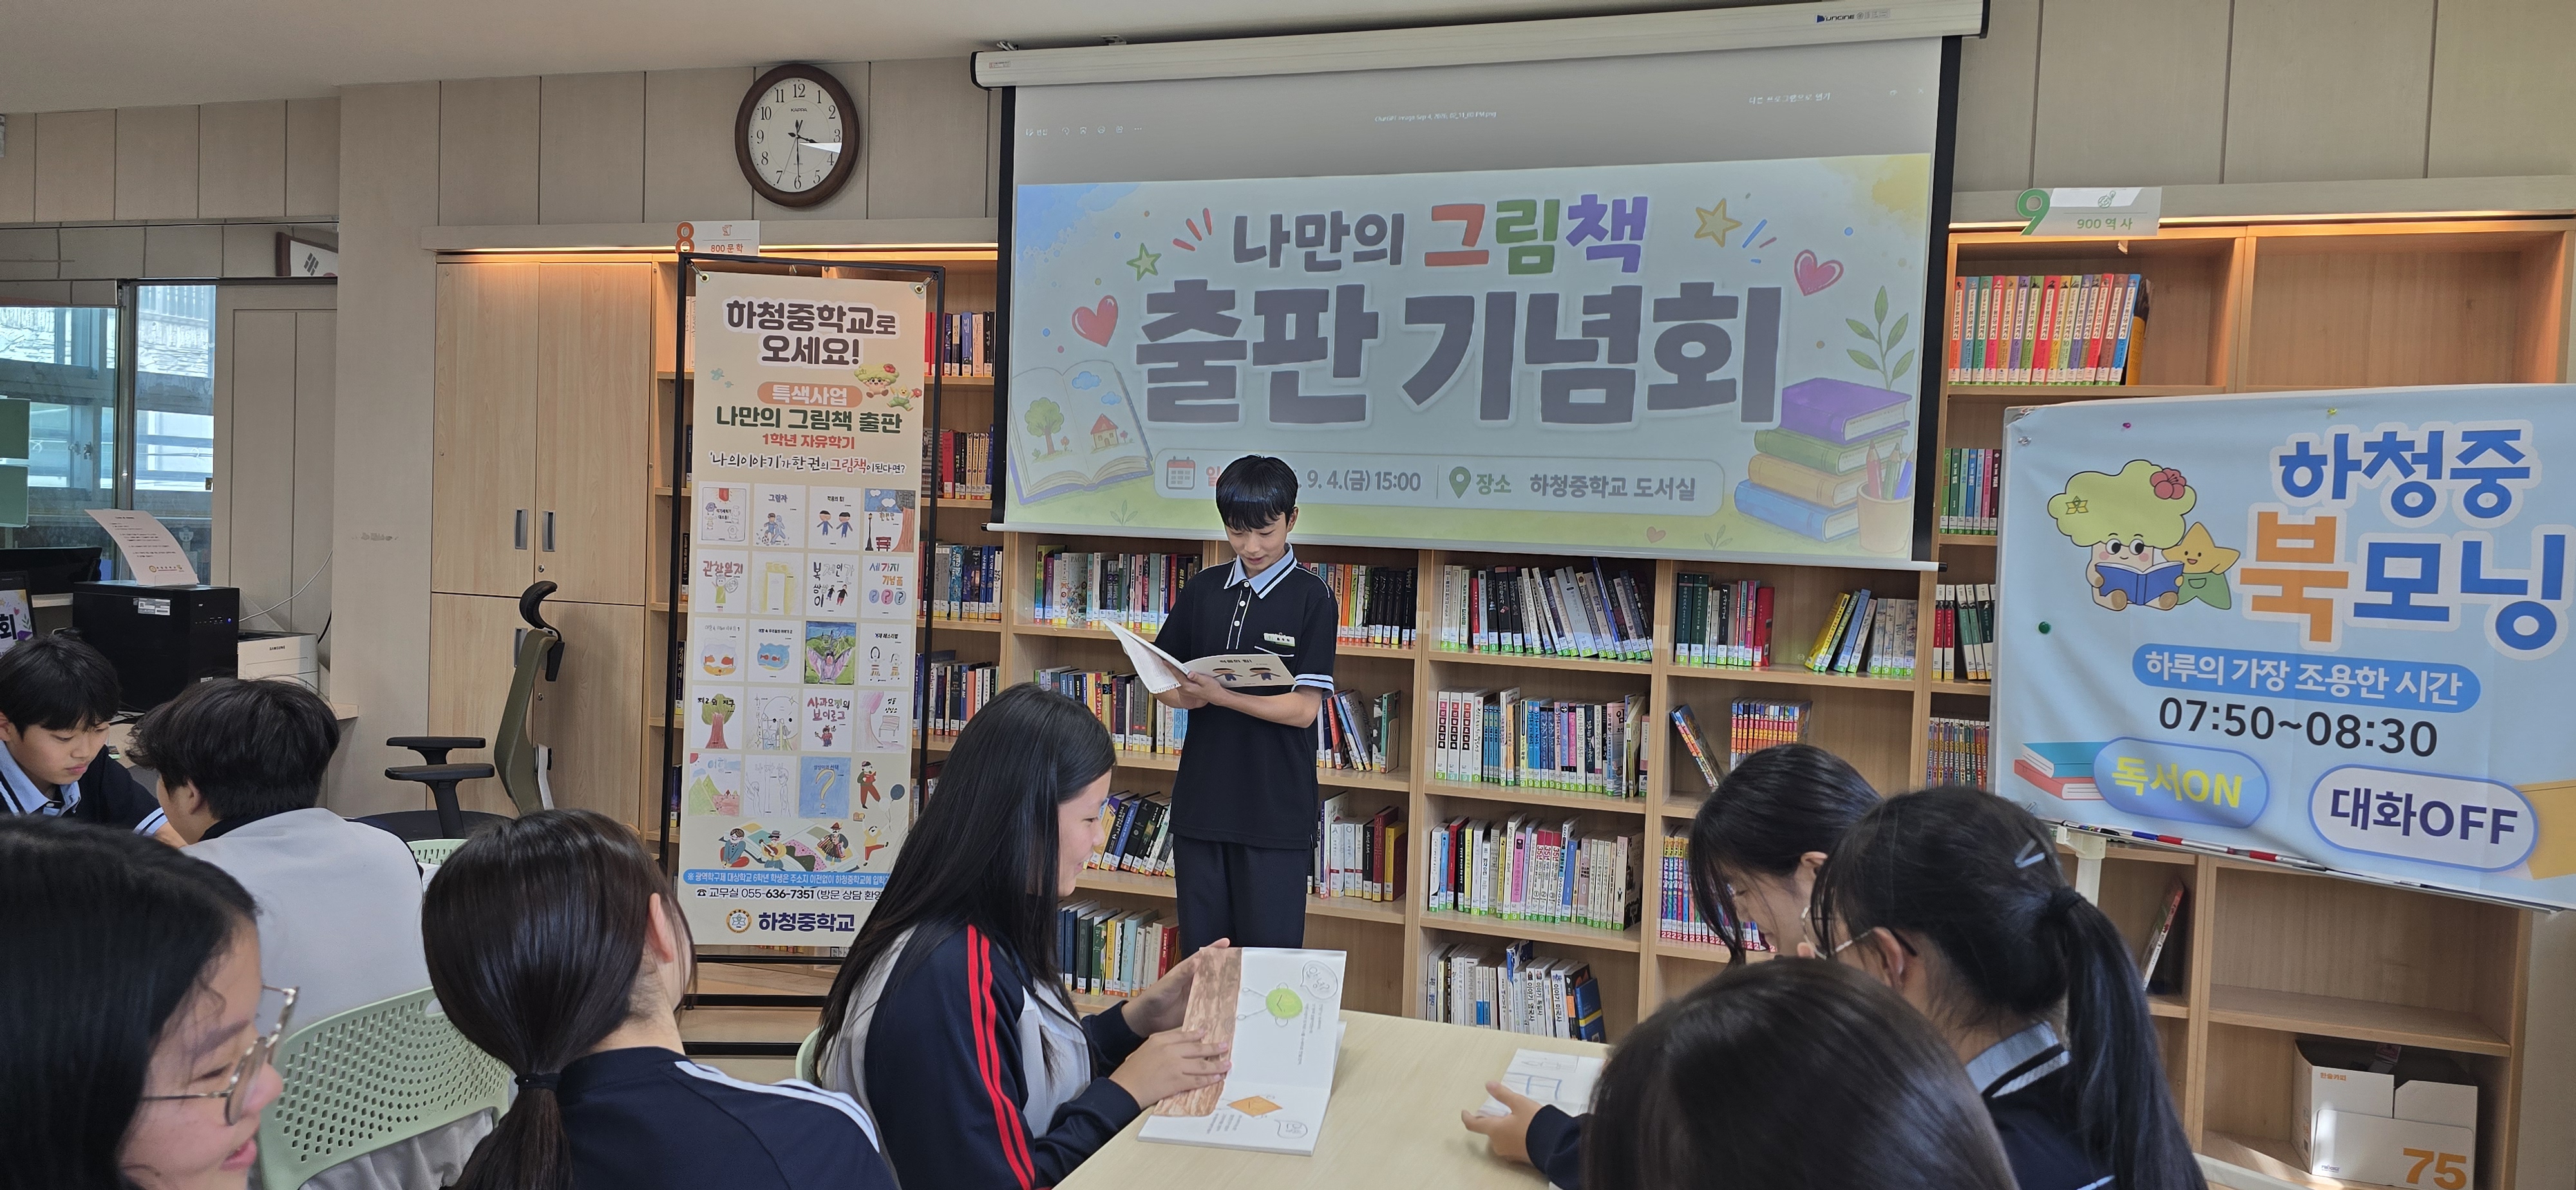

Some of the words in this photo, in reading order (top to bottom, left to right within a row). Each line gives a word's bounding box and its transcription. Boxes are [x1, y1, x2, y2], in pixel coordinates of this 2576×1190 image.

[775, 89, 785, 103] 11
[793, 83, 805, 98] 12
[817, 90, 822, 104] 1
[761, 106, 772, 120] 10
[828, 105, 836, 119] 2
[757, 129, 764, 144] 9
[833, 129, 841, 143] 3
[761, 151, 768, 165] 8
[826, 152, 834, 165] 4
[775, 170, 784, 184] 7
[794, 175, 802, 189] 6
[813, 169, 820, 184] 5
[2017, 188, 2050, 235] 9
[2077, 218, 2101, 230] 900
[676, 222, 695, 252] 8
[1232, 209, 1406, 272] 나만의
[1423, 193, 1649, 275] 그림책
[711, 244, 725, 253] 800
[727, 300, 896, 335] 하청중학교로
[761, 335, 860, 365] 오세요!
[1135, 278, 1380, 424] 출판
[1400, 281, 1783, 424] 기념회
[772, 384, 848, 406] 특색사업
[716, 406, 781, 428] 나만의
[788, 409, 852, 431] 그림책
[859, 411, 903, 434] 출판
[762, 433, 797, 448] 1학년
[800, 435, 855, 449] 자유학기
[1376, 471, 1421, 492] 15:00
[2278, 428, 2530, 519] 하청중
[1476, 473, 1512, 496] 장소
[1530, 473, 1628, 499] 하청중학교
[1633, 477, 1696, 502] 도서실
[768, 494, 788, 503] 그림자
[703, 560, 743, 578] 관찰일지
[2239, 511, 2567, 650] 북모닝
[2145, 652, 2224, 686] 하루의
[2231, 657, 2289, 694] 가장
[2295, 665, 2389, 701] 조용한
[2394, 670, 2463, 706] 시간
[807, 697, 850, 710] 사과요정의
[813, 709, 846, 722] 브이로그
[2158, 697, 2438, 758] 07:50~08:30
[2111, 756, 2244, 809] 독서ON
[2330, 785, 2519, 846] 대화OFF
[695, 872, 726, 882] 광역학구제
[728, 873, 752, 882] 대상학교
[753, 873, 770, 883] 6학년
[770, 873, 789, 883] 학생은
[790, 874, 809, 883] 주소지
[810, 874, 834, 884] 이전없이
[835, 874, 871, 885] 하청중학교에
[709, 887, 739, 898] 교무실
[741, 889, 814, 899] 055-636-7351
[817, 889, 840, 900] (방문
[842, 890, 862, 900] 상담
[759, 912, 855, 932] 하청중학교
[2320, 1072, 2347, 1081] 한솔카피
[2403, 1148, 2467, 1190] 75
